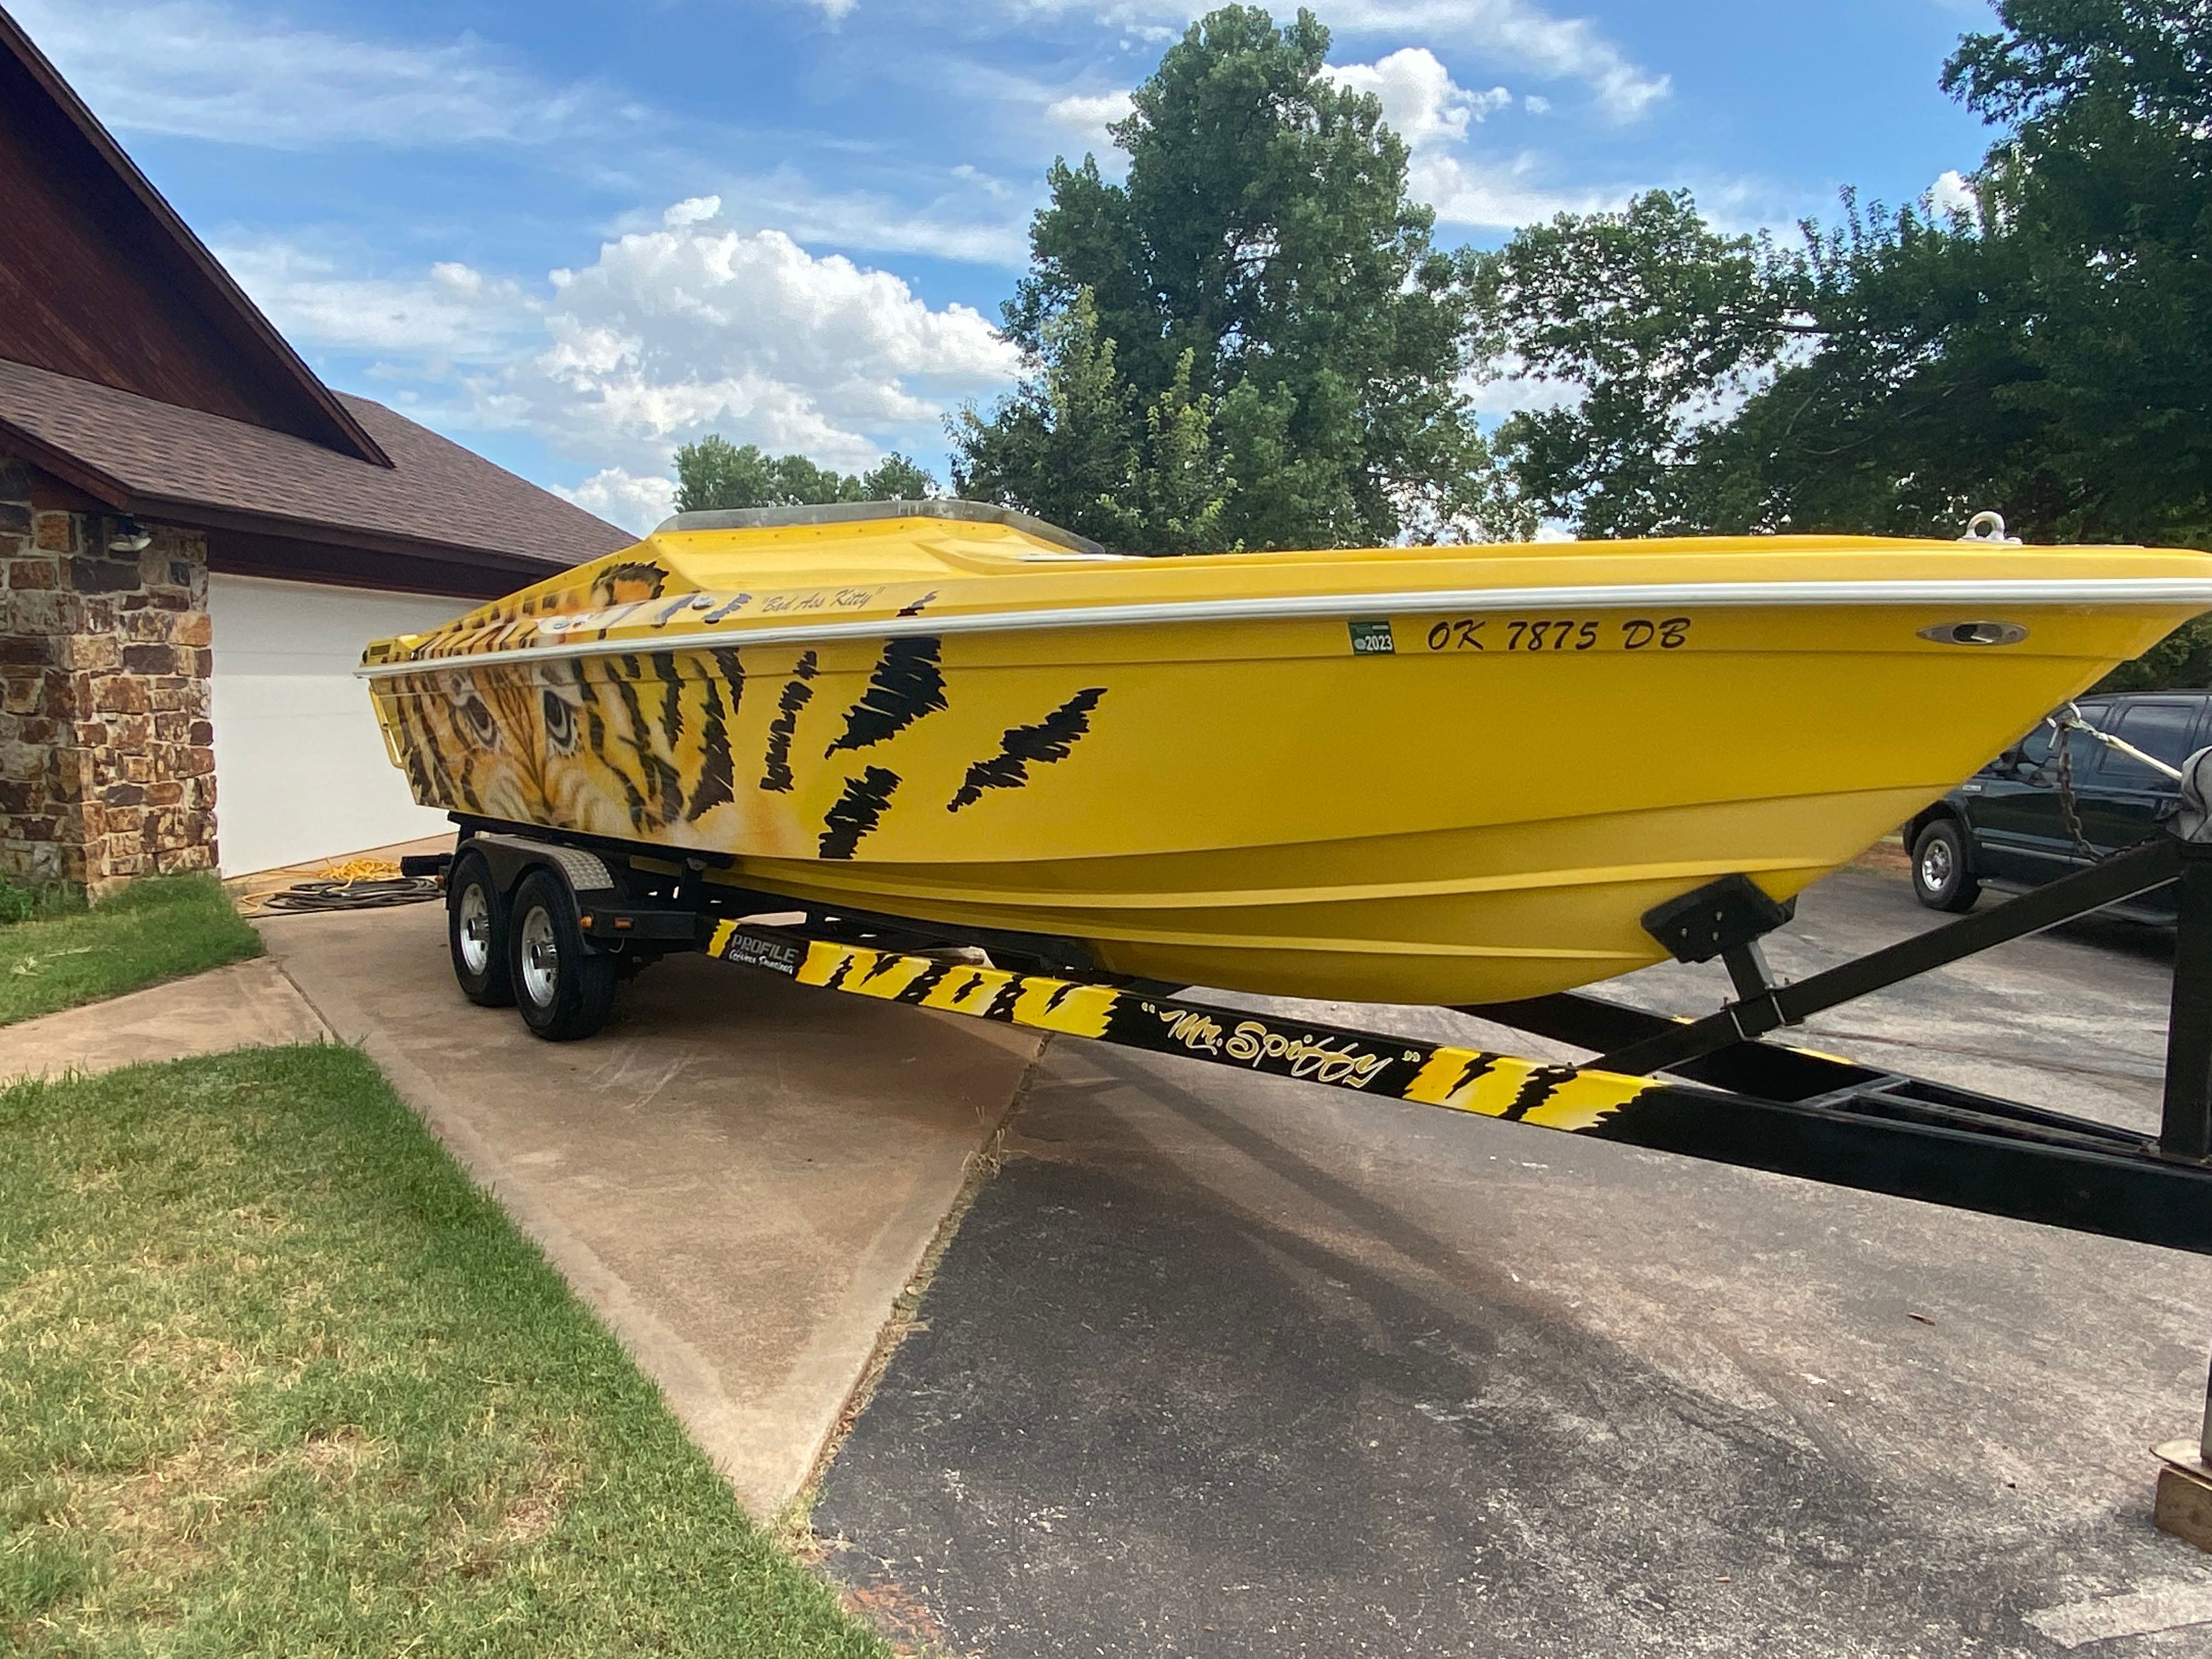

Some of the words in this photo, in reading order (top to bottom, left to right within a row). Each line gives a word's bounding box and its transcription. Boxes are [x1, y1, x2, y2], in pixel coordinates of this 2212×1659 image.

[1365, 635, 1392, 651] 2023
[1427, 618, 1486, 651] OK
[1506, 620, 1599, 651] 7875
[1622, 617, 1691, 649] DB
[731, 934, 799, 963] PROFILE
